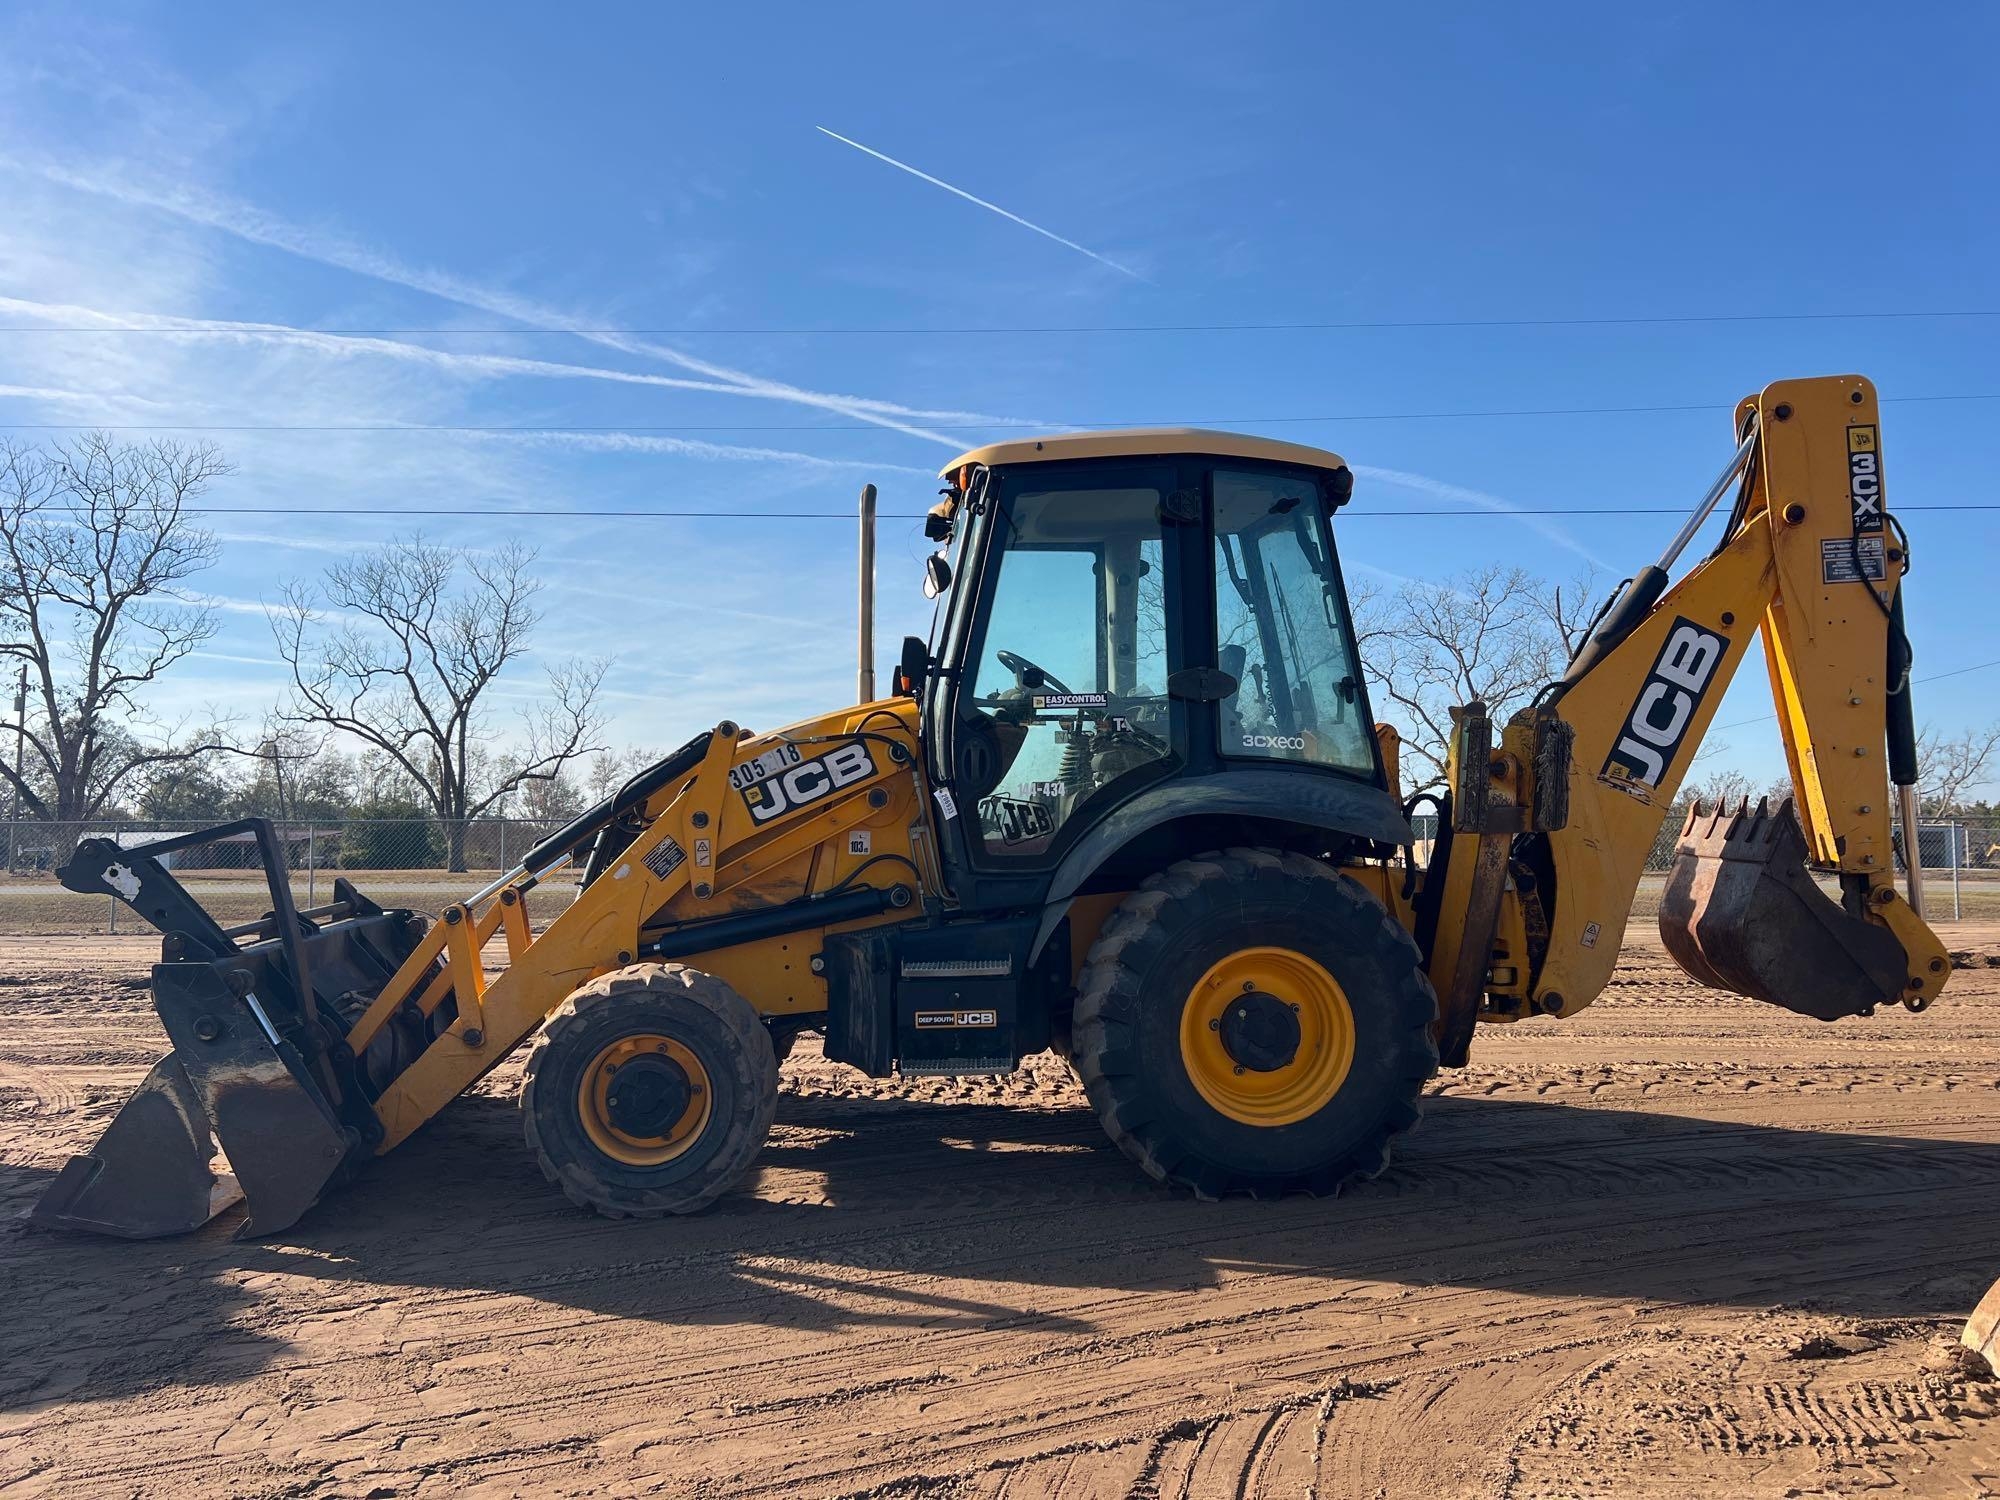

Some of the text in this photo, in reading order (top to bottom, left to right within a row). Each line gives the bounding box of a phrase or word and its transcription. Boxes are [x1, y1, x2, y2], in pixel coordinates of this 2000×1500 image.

[1852, 453, 1880, 516] 3CX
[1046, 695, 1106, 707] EASYCONTROL
[1618, 625, 1721, 788] JCB
[1242, 734, 1305, 750] 3CXeco
[751, 743, 873, 820] JCB
[1018, 783, 1066, 797] 144-434
[1002, 802, 1051, 841] JCB
[850, 841, 864, 853] 103
[958, 1014, 993, 1024] JCB
